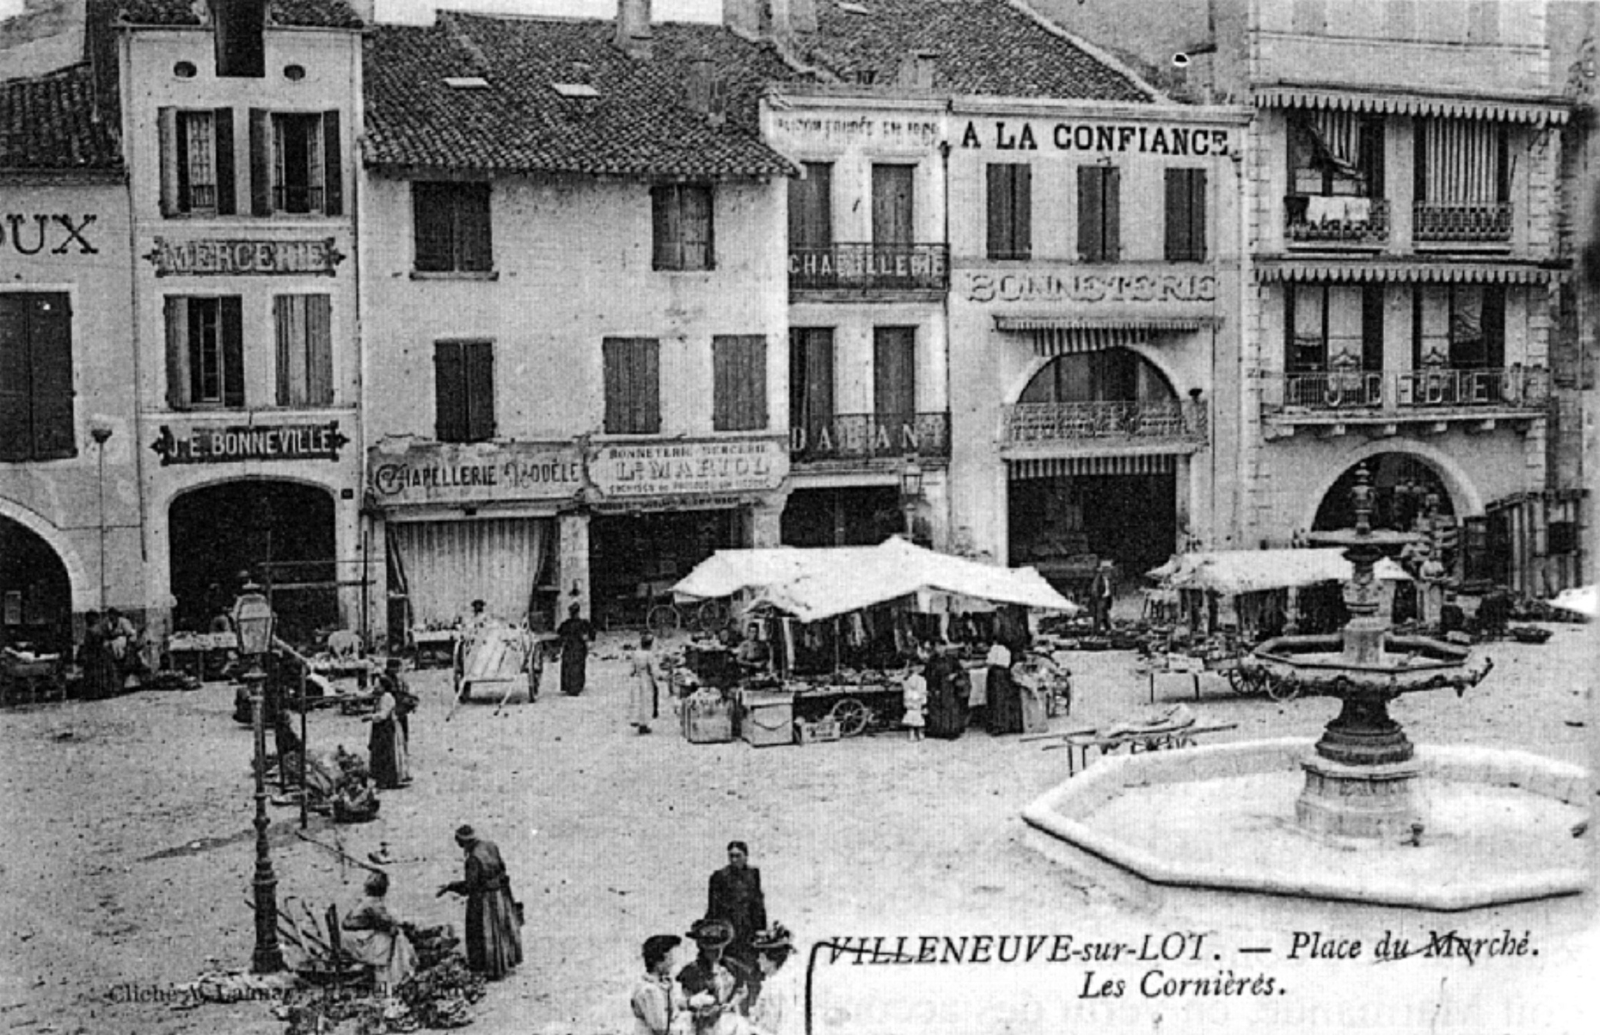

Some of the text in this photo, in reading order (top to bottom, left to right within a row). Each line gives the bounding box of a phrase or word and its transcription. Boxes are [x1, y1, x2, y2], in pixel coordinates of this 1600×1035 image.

[961, 120, 1229, 157] A LA CONFIANCE
[0, 213, 99, 255] UX
[164, 241, 328, 272] MERCERIE
[967, 274, 1217, 303] BONNETERIE
[211, 428, 333, 456] BONNEVILLE
